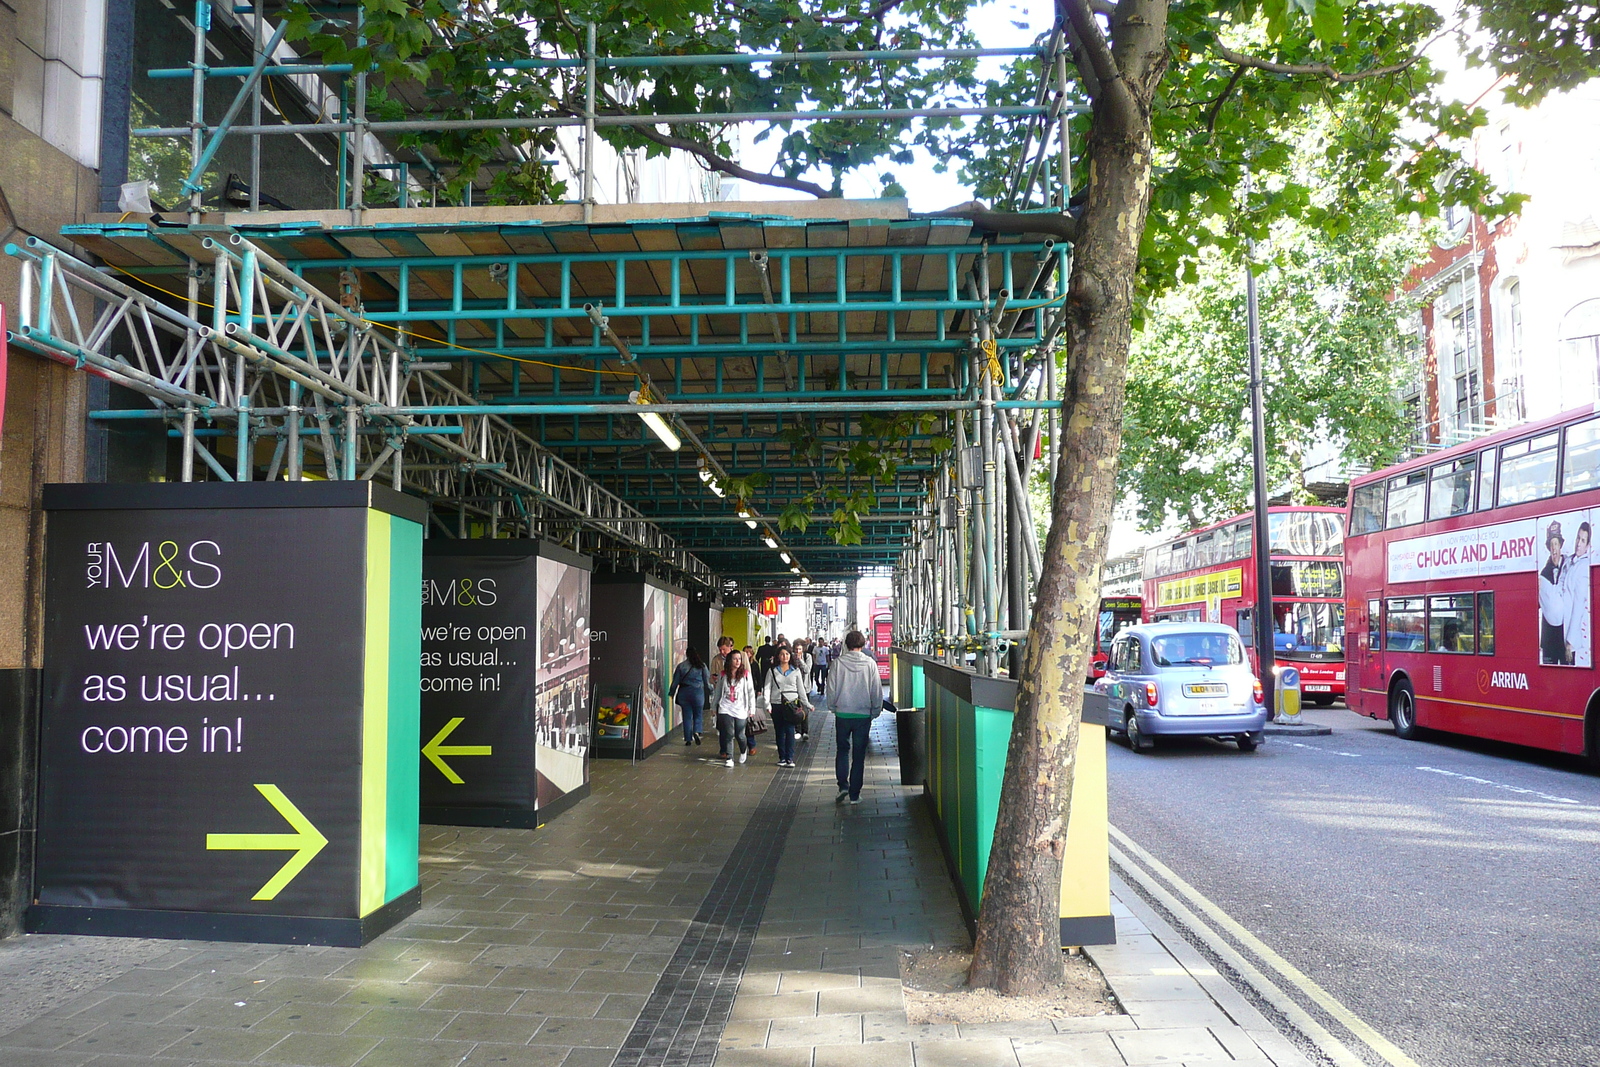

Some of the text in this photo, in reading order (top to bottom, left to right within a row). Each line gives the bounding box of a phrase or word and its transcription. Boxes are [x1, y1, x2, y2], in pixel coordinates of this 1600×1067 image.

[1417, 535, 1536, 569] CHUCK AND LARRY
[87, 540, 222, 589] YOUR M&S
[1325, 568, 1337, 580] 55
[430, 578, 497, 606] M&S
[1299, 582, 1322, 590] eyton
[85, 615, 295, 658] we're open
[420, 622, 526, 645] we're open
[590, 630, 608, 642] en
[420, 652, 442, 667] as
[84, 674, 128, 702] as
[420, 673, 501, 692] come in!
[1491, 671, 1529, 690] ARRIVA
[83, 717, 243, 753] come in!
